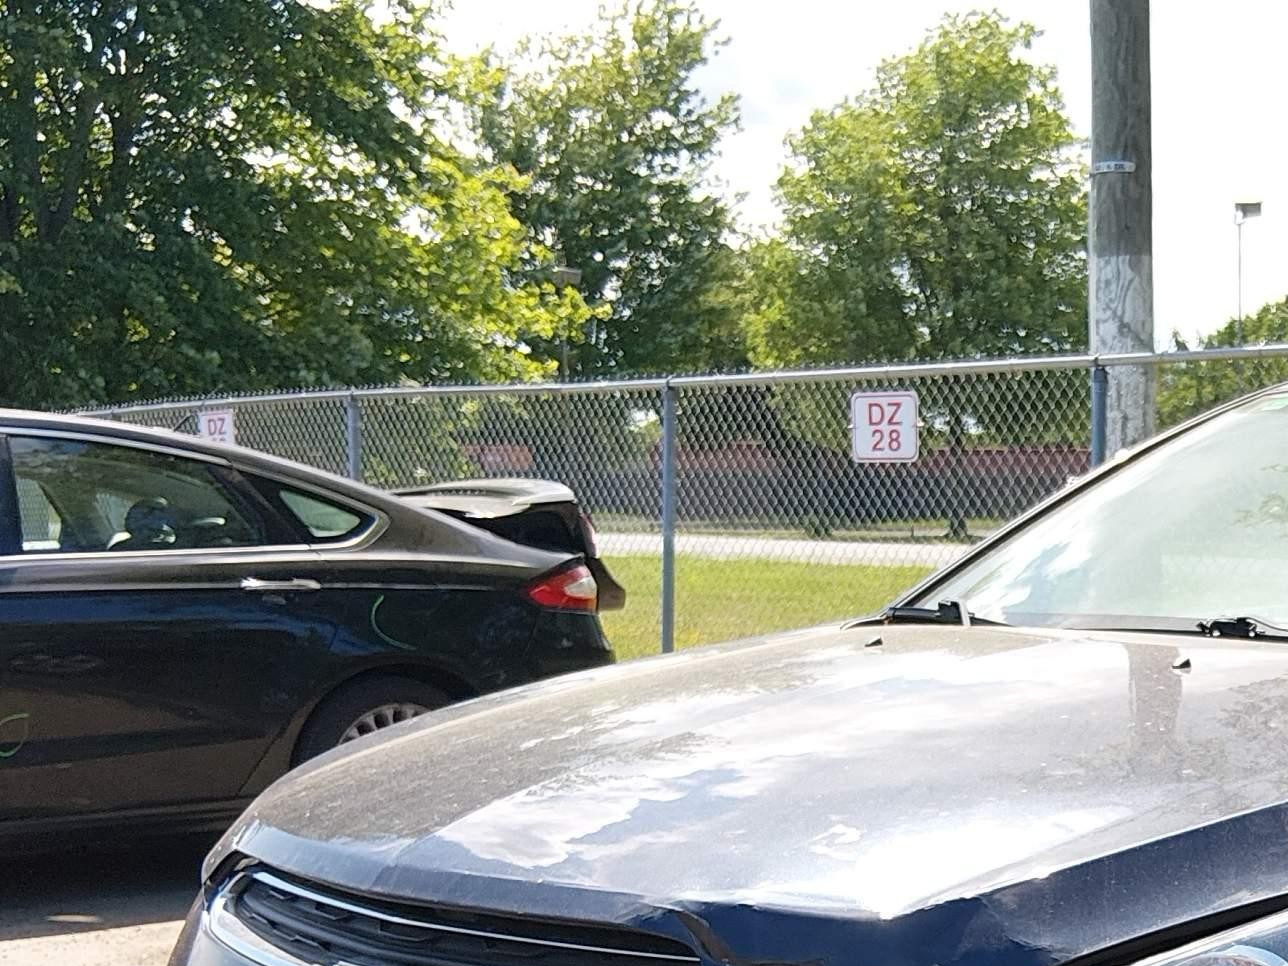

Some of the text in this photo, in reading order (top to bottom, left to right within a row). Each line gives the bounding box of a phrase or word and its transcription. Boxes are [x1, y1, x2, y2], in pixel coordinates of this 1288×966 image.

[868, 402, 903, 426] DZ
[208, 417, 226, 436] DZ
[871, 429, 902, 452] 28
